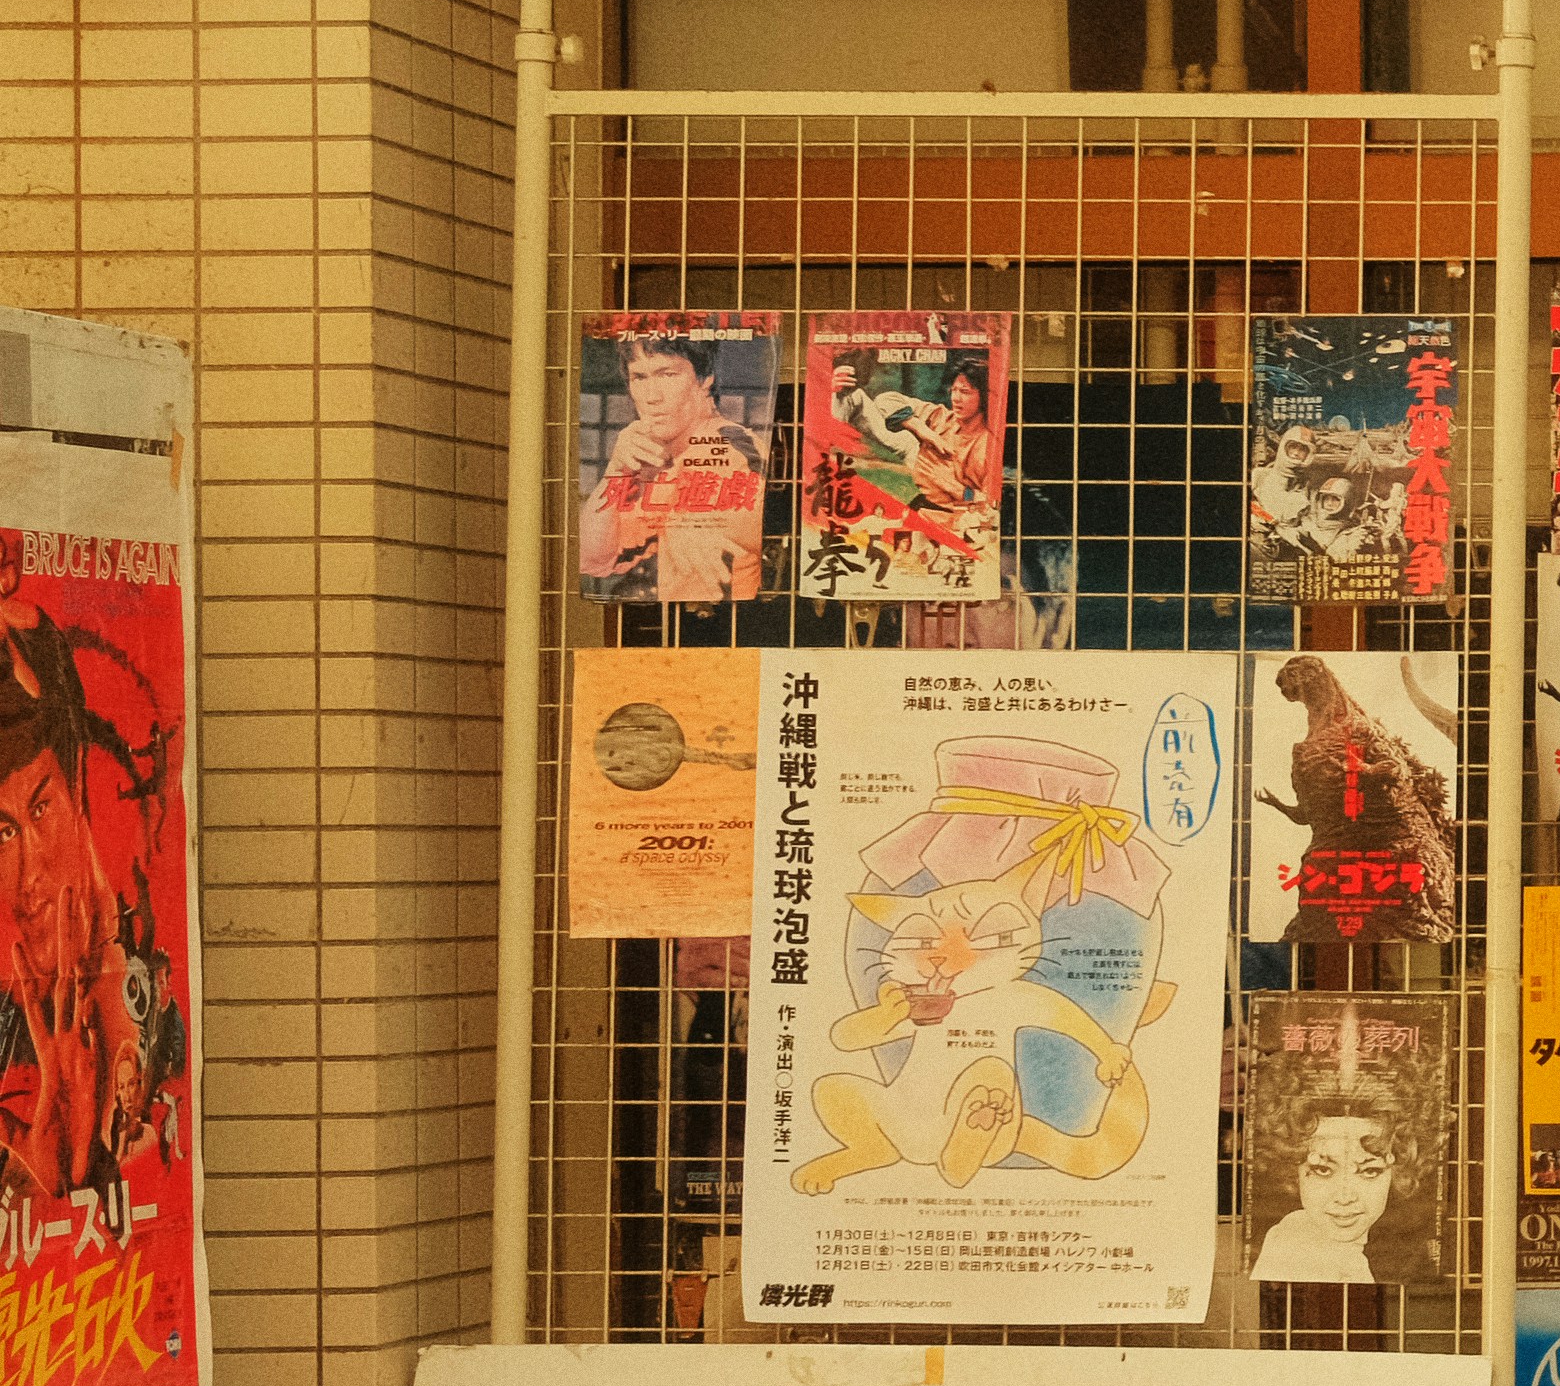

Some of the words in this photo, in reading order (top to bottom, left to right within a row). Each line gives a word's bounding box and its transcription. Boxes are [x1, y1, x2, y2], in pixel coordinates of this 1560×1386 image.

[689, 437, 729, 445] GAME
[711, 448, 729, 456] OF
[683, 458, 729, 467] DEATH
[22, 531, 90, 579] BRUCE
[95, 538, 112, 580] IS
[115, 541, 181, 588] AGAIN
[653, 823, 694, 831] years
[699, 822, 714, 830] to
[770, 670, 820, 987] 沖縄戦と琉球泡盛
[637, 835, 715, 850] 2001:
[1277, 862, 1425, 893] シン・ゴジラ
[1536, 1242, 1551, 1250] The
